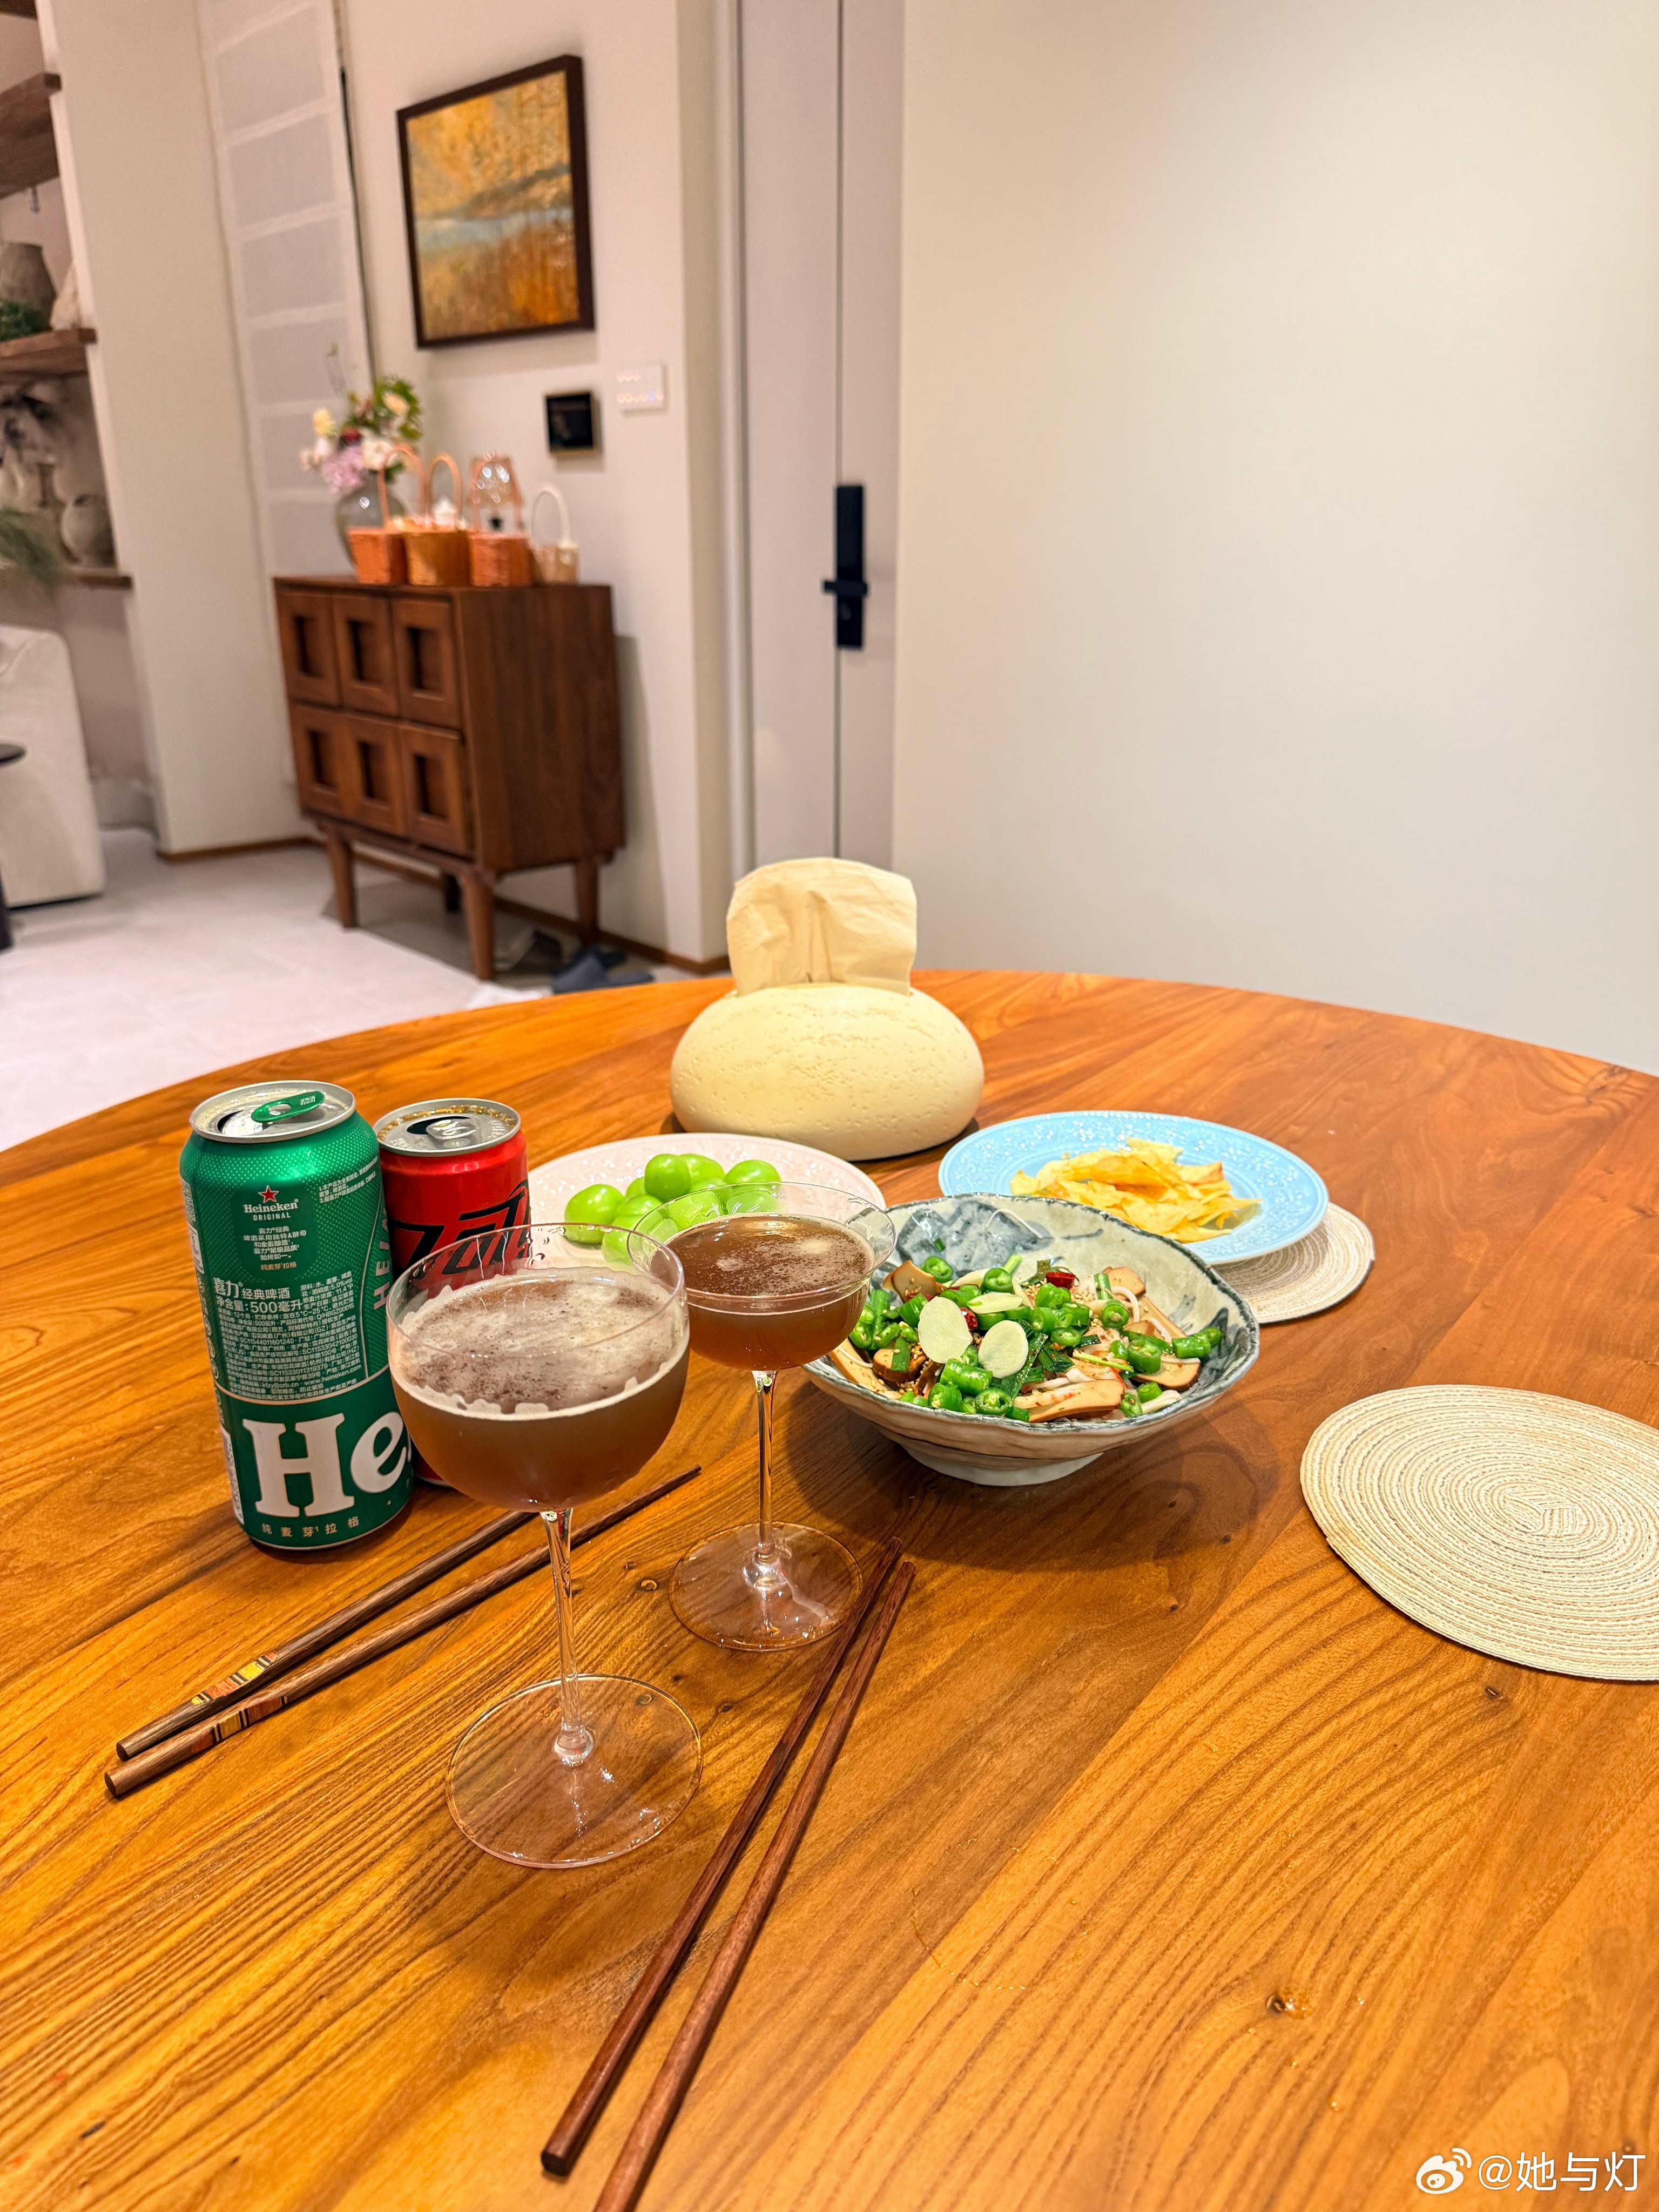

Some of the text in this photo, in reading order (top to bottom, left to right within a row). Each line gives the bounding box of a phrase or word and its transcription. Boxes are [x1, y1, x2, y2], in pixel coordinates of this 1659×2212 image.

[253, 1212, 291, 1221] ORIGINAL
[216, 1295, 303, 1314] 净含量:500毫升
